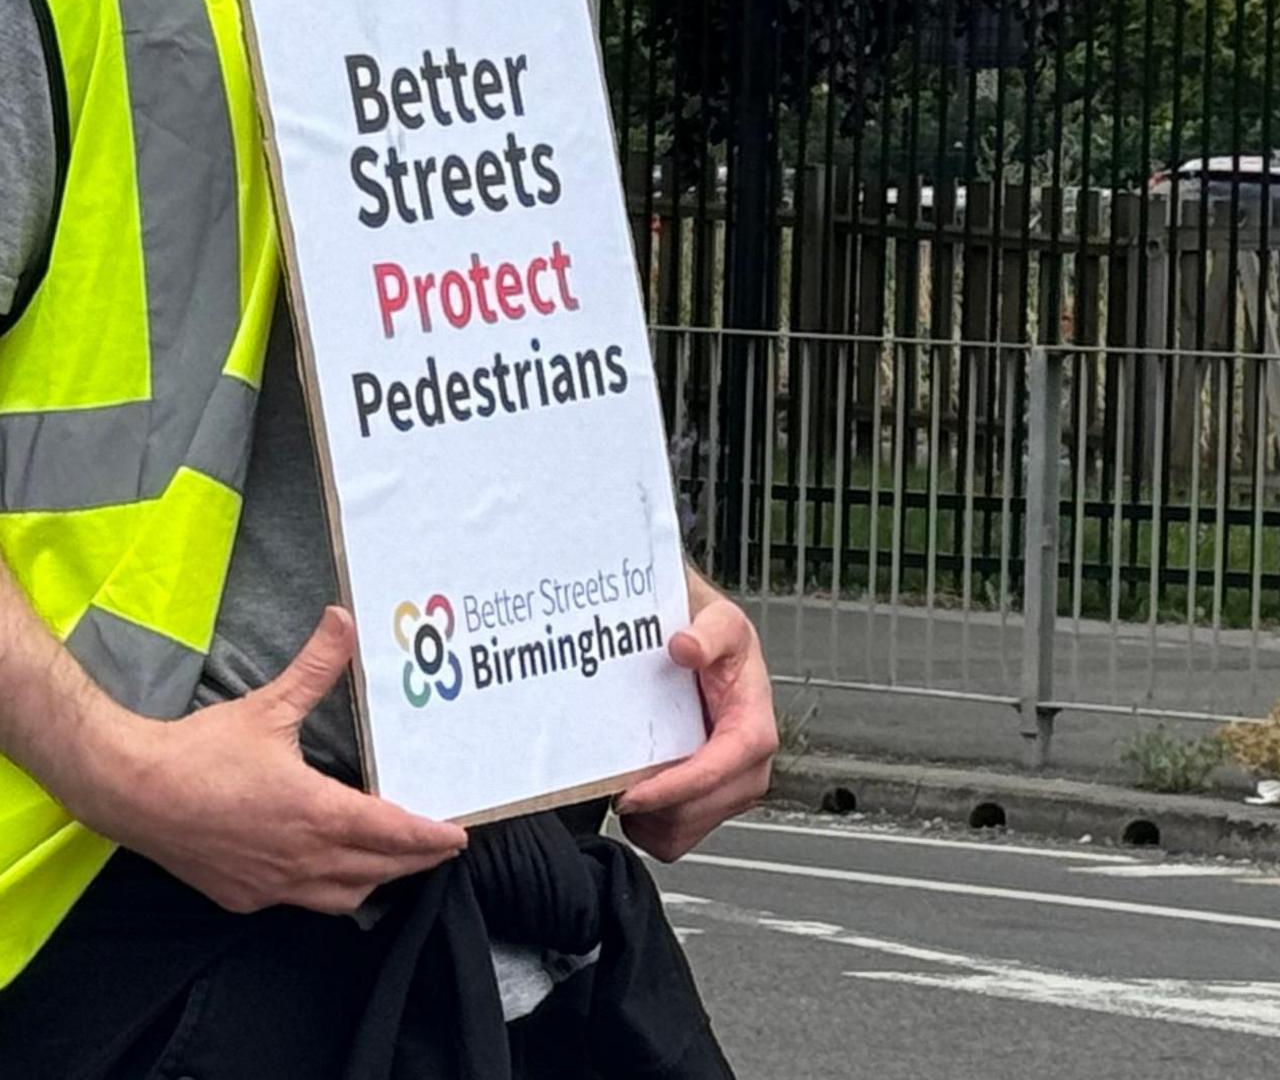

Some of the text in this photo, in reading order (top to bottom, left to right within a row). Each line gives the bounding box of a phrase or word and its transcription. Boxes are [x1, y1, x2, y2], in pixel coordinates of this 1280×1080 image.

[344, 47, 528, 135] Better
[350, 132, 562, 229] Streets
[373, 241, 579, 338] Protect
[351, 337, 628, 438] Pedestrians
[463, 557, 654, 633] Better Streets for
[470, 613, 664, 690] Birmingham
